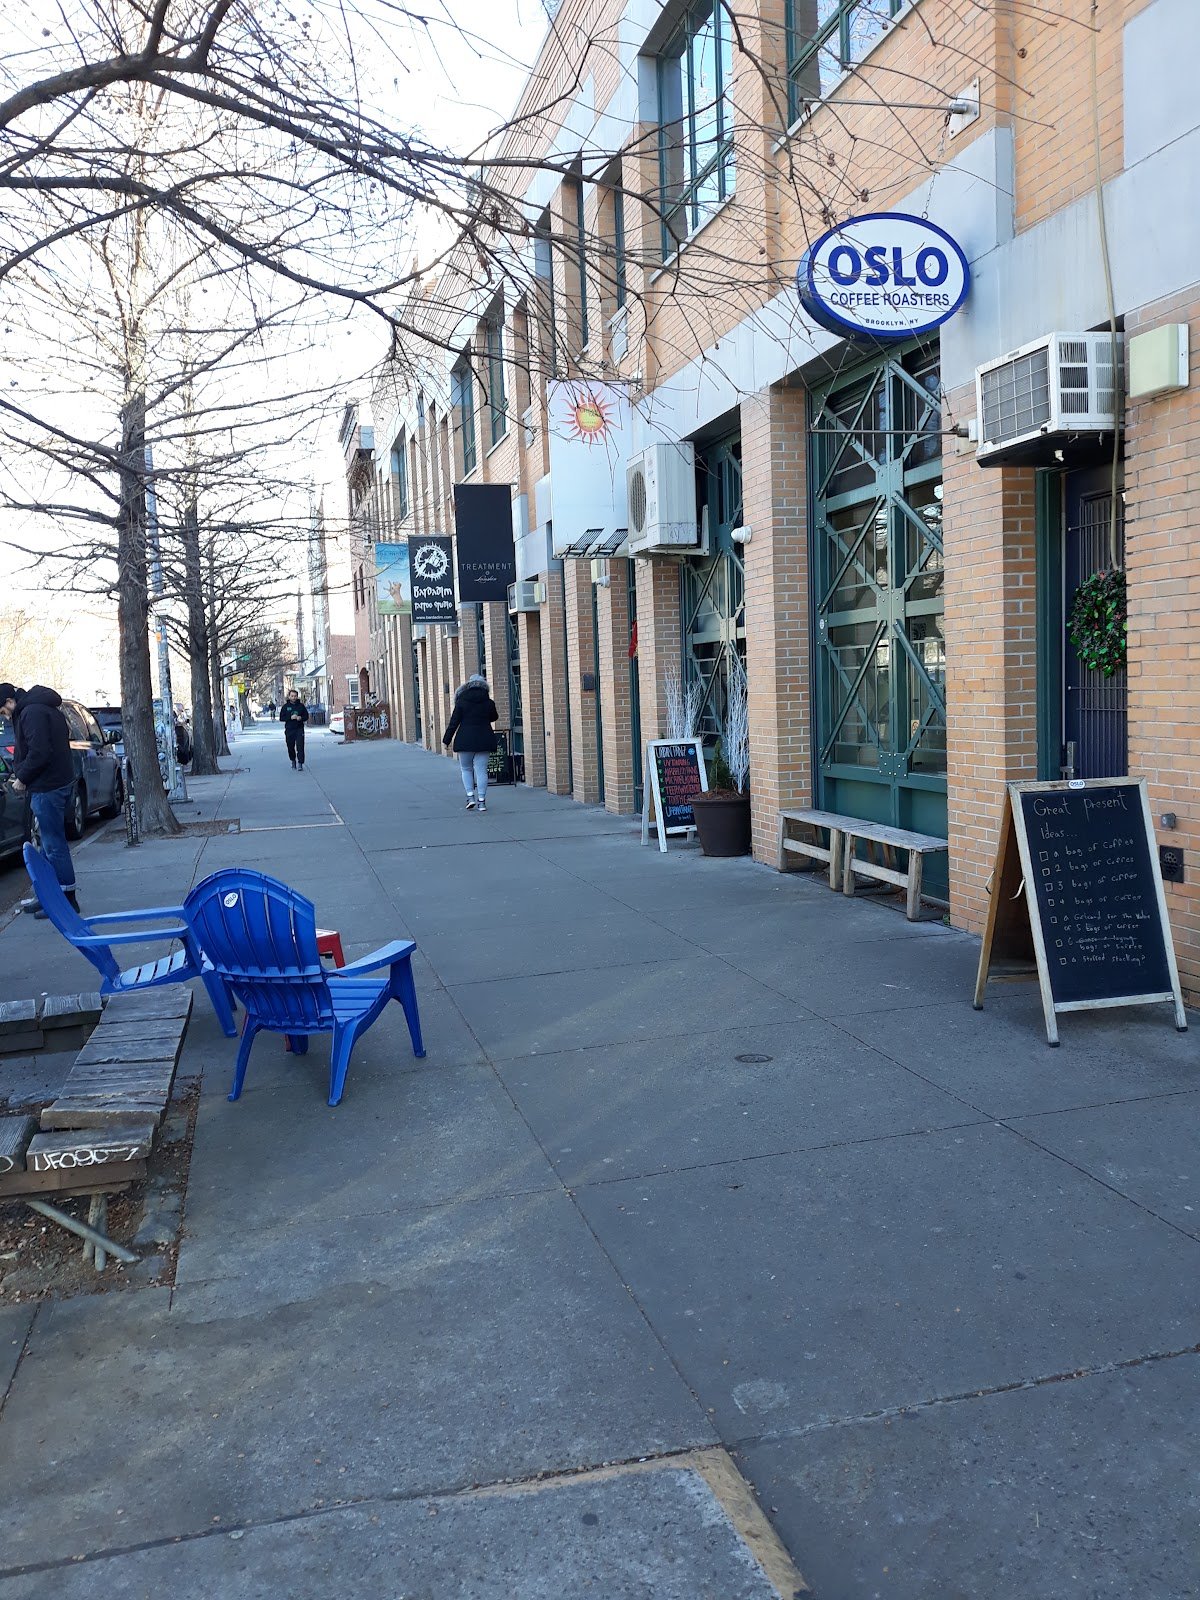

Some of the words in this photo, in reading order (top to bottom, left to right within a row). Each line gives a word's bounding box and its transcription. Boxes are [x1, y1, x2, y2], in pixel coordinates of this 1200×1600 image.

[828, 245, 949, 287] OSLO
[831, 292, 880, 306] COFFEE
[884, 293, 950, 306] ROASTERS
[1034, 797, 1071, 816] Great
[1065, 845, 1083, 857] bag
[1088, 842, 1098, 852] of
[1055, 864, 1062, 872] 2
[1069, 861, 1089, 872] bags
[1093, 859, 1102, 867] of
[1098, 876, 1106, 884] of
[1074, 897, 1093, 906] bags
